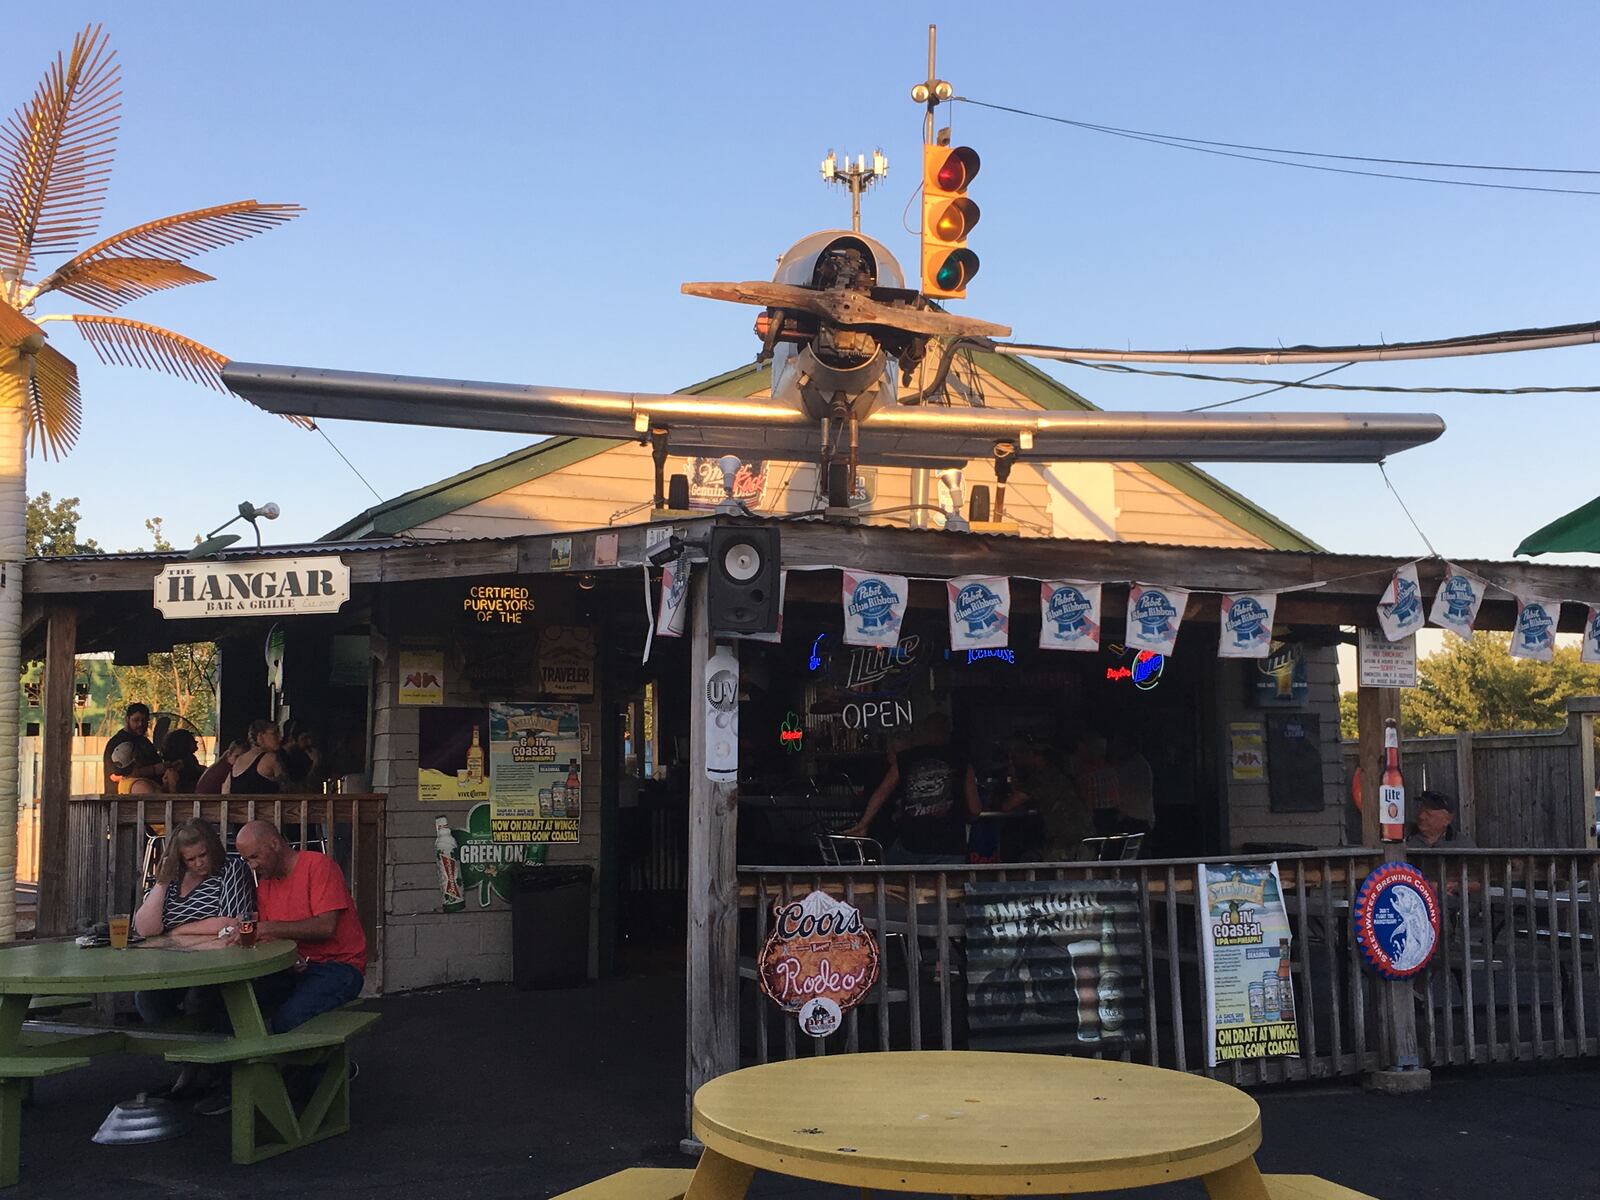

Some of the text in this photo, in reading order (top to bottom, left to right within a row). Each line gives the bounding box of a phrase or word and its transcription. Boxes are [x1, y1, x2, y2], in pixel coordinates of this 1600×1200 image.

[166, 570, 337, 602] HANGAR
[470, 586, 529, 599] CERTIFIED
[857, 585, 882, 600] Pabst
[1451, 580, 1467, 591] Pabst
[959, 588, 983, 607] Pabst
[1053, 592, 1076, 607] Pabst
[1141, 595, 1162, 608] Pabst
[1442, 591, 1475, 601] Blue Ribbon
[206, 599, 295, 611] BAR & GRILLE
[464, 599, 536, 611] PURVEYORS
[849, 595, 898, 616] Blue Ribbon
[954, 596, 1000, 622] Blue Ribbon
[1047, 602, 1091, 621] Blue Ribbon
[1232, 602, 1253, 617] Pabst
[476, 611, 522, 624] OF THE
[1131, 607, 1176, 621] Blue Ribbon
[1226, 611, 1268, 631] Blue Ribbon
[542, 666, 589, 683] TRAVELER
[842, 699, 914, 729] OPEN
[1385, 789, 1401, 803] Lite
[492, 820, 510, 831] NOW
[510, 820, 522, 831] ON
[522, 820, 544, 831] DRAFT
[544, 820, 553, 831] AT
[493, 831, 531, 842] SWEETWATER
[551, 831, 578, 841] COASTAL
[460, 845, 502, 864] GREEN
[504, 844, 524, 863] ON
[775, 903, 863, 939] Coors
[1365, 874, 1437, 963] SWEETWATER BREWING COMPANY
[1237, 936, 1262, 944] PINEAPPLE
[777, 958, 865, 999] Rodeo
[1218, 1024, 1296, 1045] ON DRAFT AT WINGS
